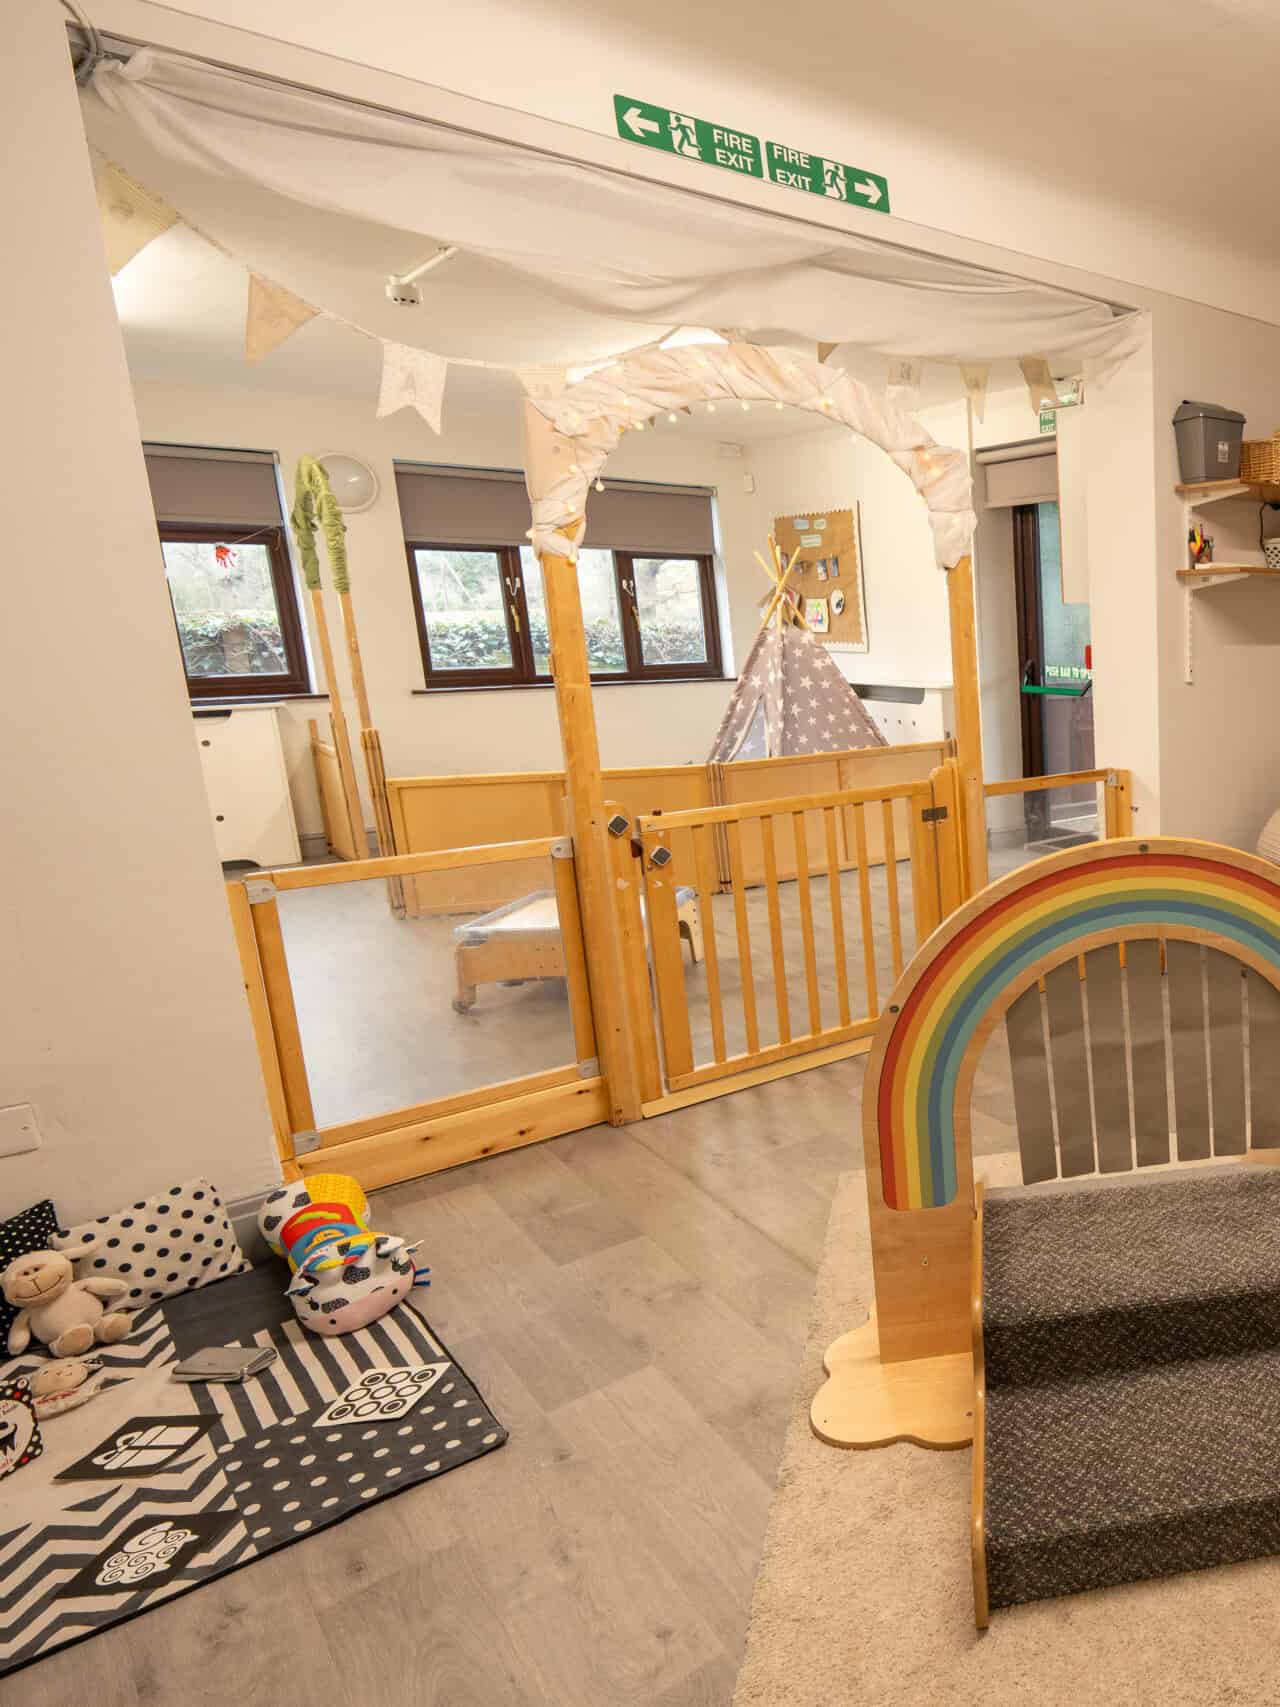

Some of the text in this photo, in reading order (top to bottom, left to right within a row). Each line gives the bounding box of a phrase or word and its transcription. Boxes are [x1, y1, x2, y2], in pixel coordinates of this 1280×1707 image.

[712, 128, 753, 154] FIRE
[715, 148, 755, 172] EXIT
[773, 144, 811, 168] FIRE
[776, 169, 812, 192] EXIT
